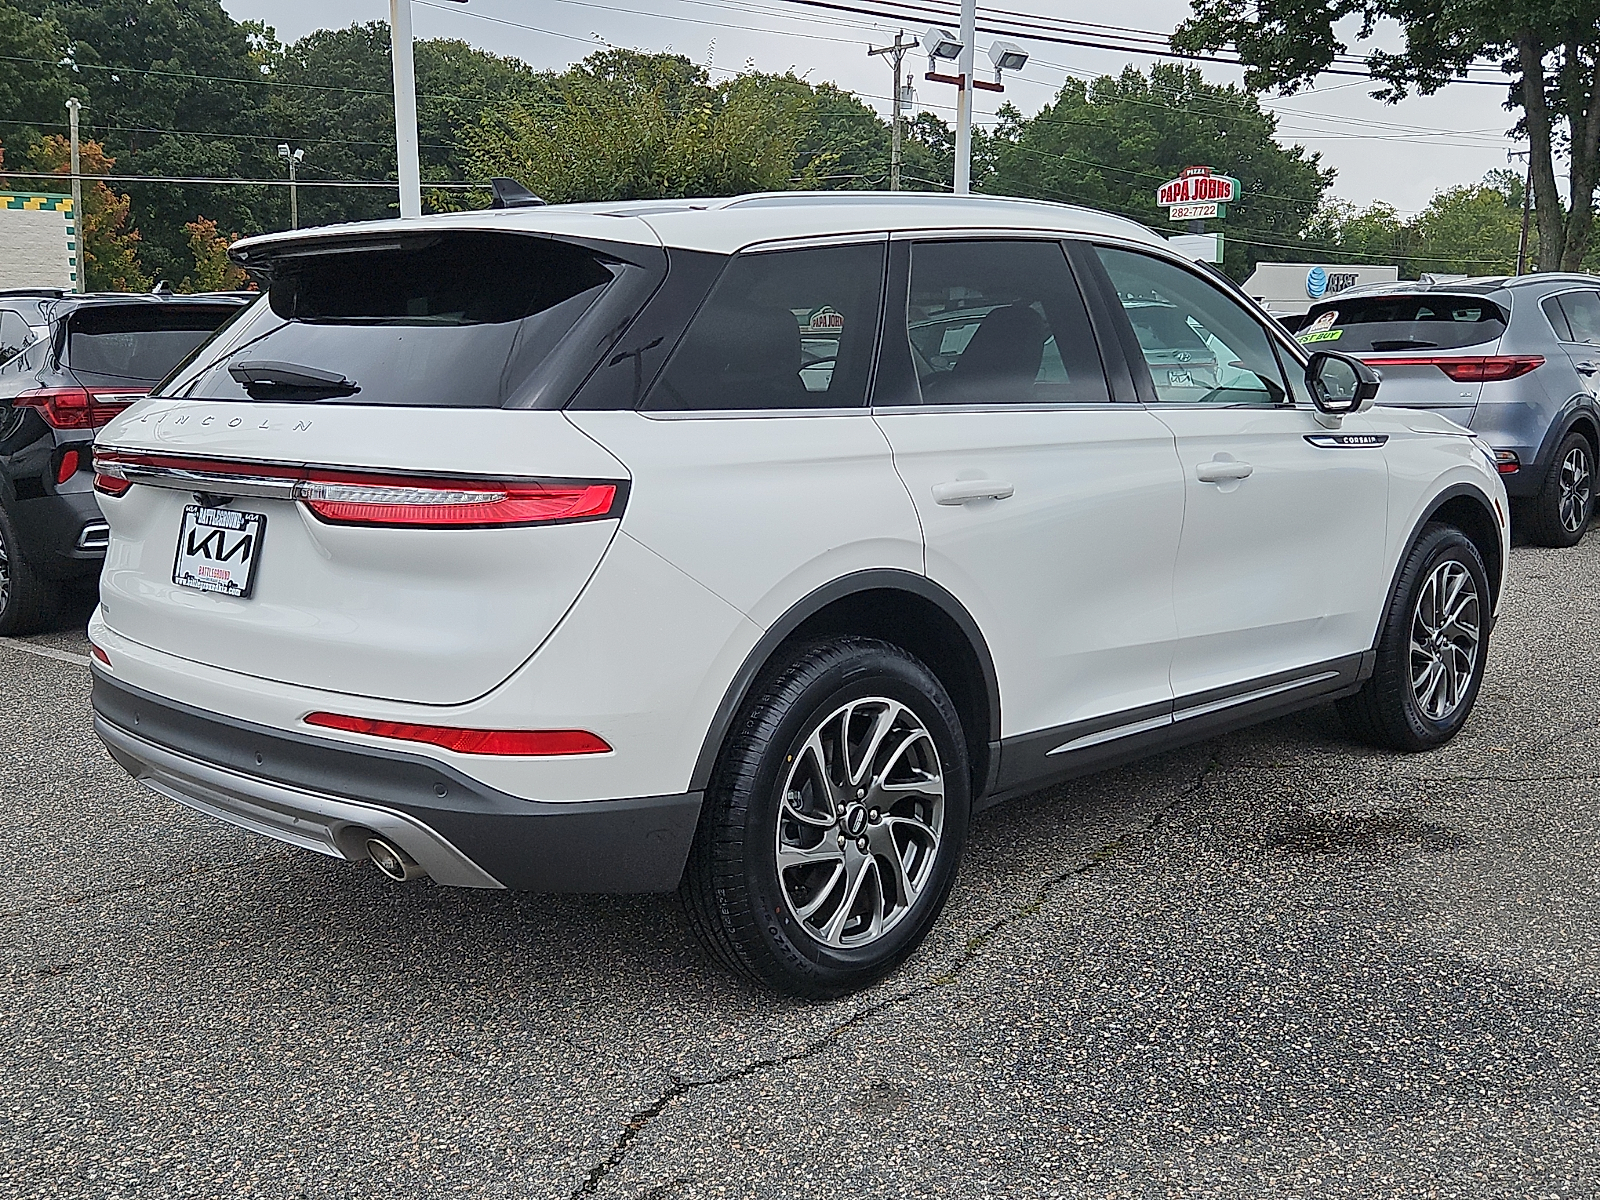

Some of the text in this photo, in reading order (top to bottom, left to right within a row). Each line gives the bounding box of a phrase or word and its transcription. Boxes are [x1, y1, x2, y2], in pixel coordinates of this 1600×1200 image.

[1160, 180, 1189, 203] PAPA
[1172, 205, 1216, 218] 282-7722
[1326, 273, 1359, 293] AT&T
[1316, 332, 1339, 341] BUY
[140, 413, 313, 432] LINCOLN
[186, 526, 253, 565] KIA
[198, 565, 231, 580] BATTLEGROUND
